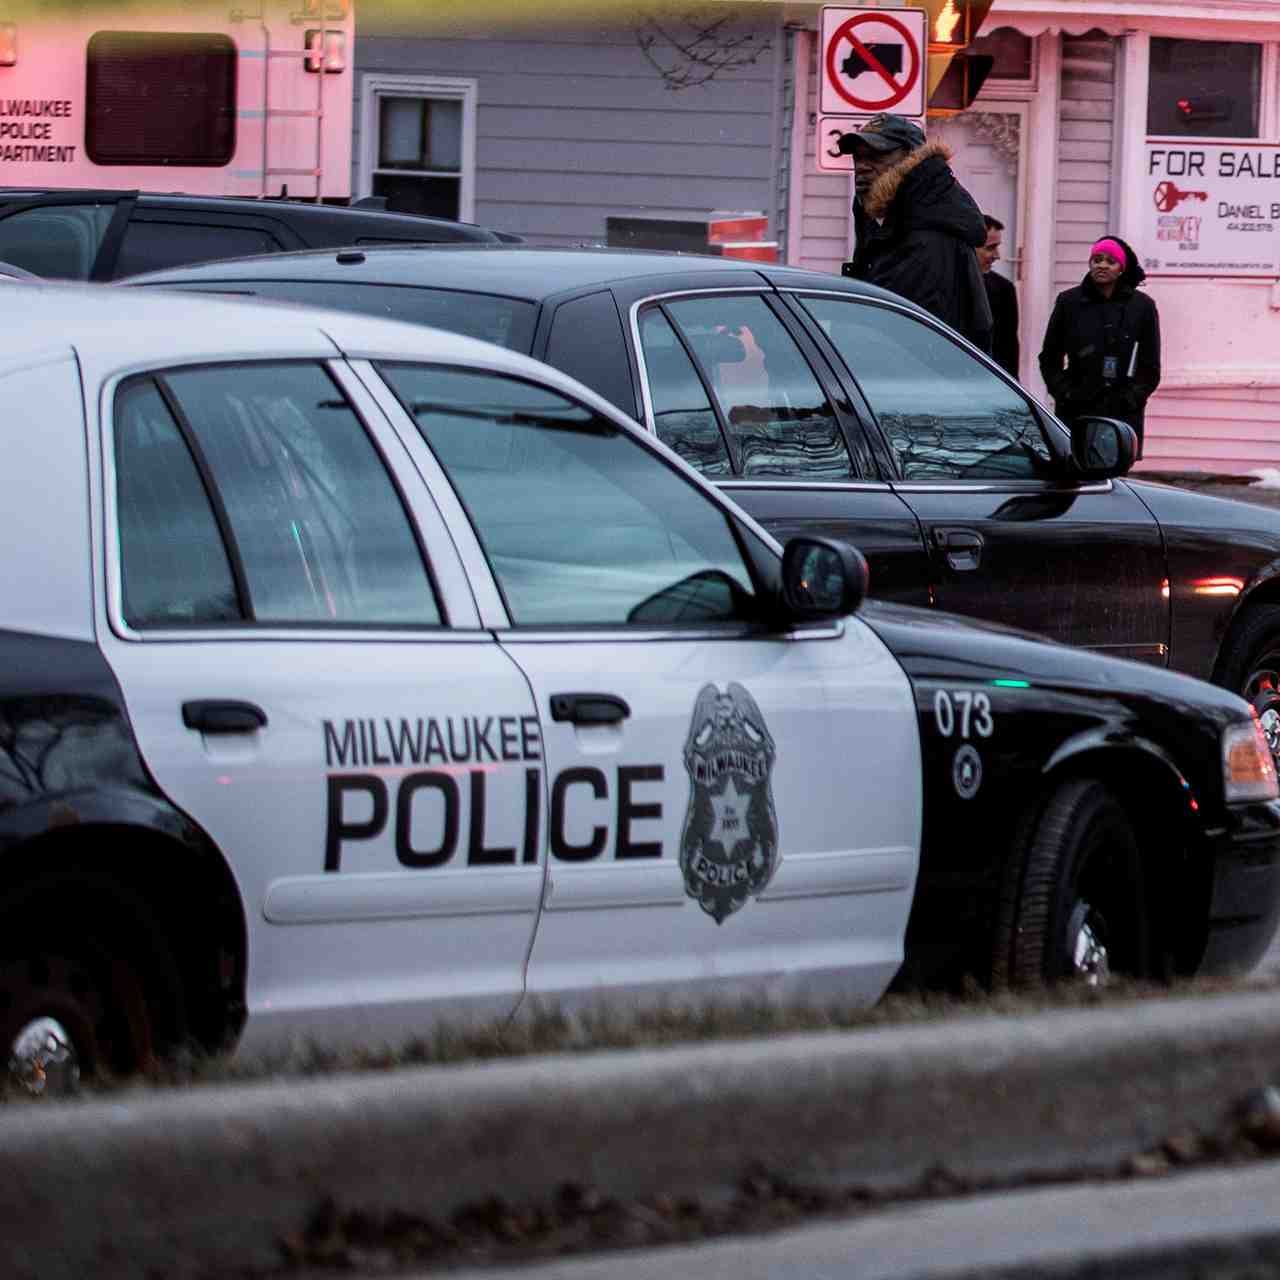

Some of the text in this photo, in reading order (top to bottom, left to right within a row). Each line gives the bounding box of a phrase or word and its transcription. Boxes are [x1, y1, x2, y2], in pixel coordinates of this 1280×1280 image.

[0, 122, 52, 139] POLICE
[1149, 150, 1205, 177] FOR
[1218, 202, 1265, 219] DANIEL
[935, 689, 993, 739] 073
[323, 716, 541, 767] MILWAUKEE
[696, 753, 768, 782] MILWAUKEE
[324, 764, 665, 873] POLICE
